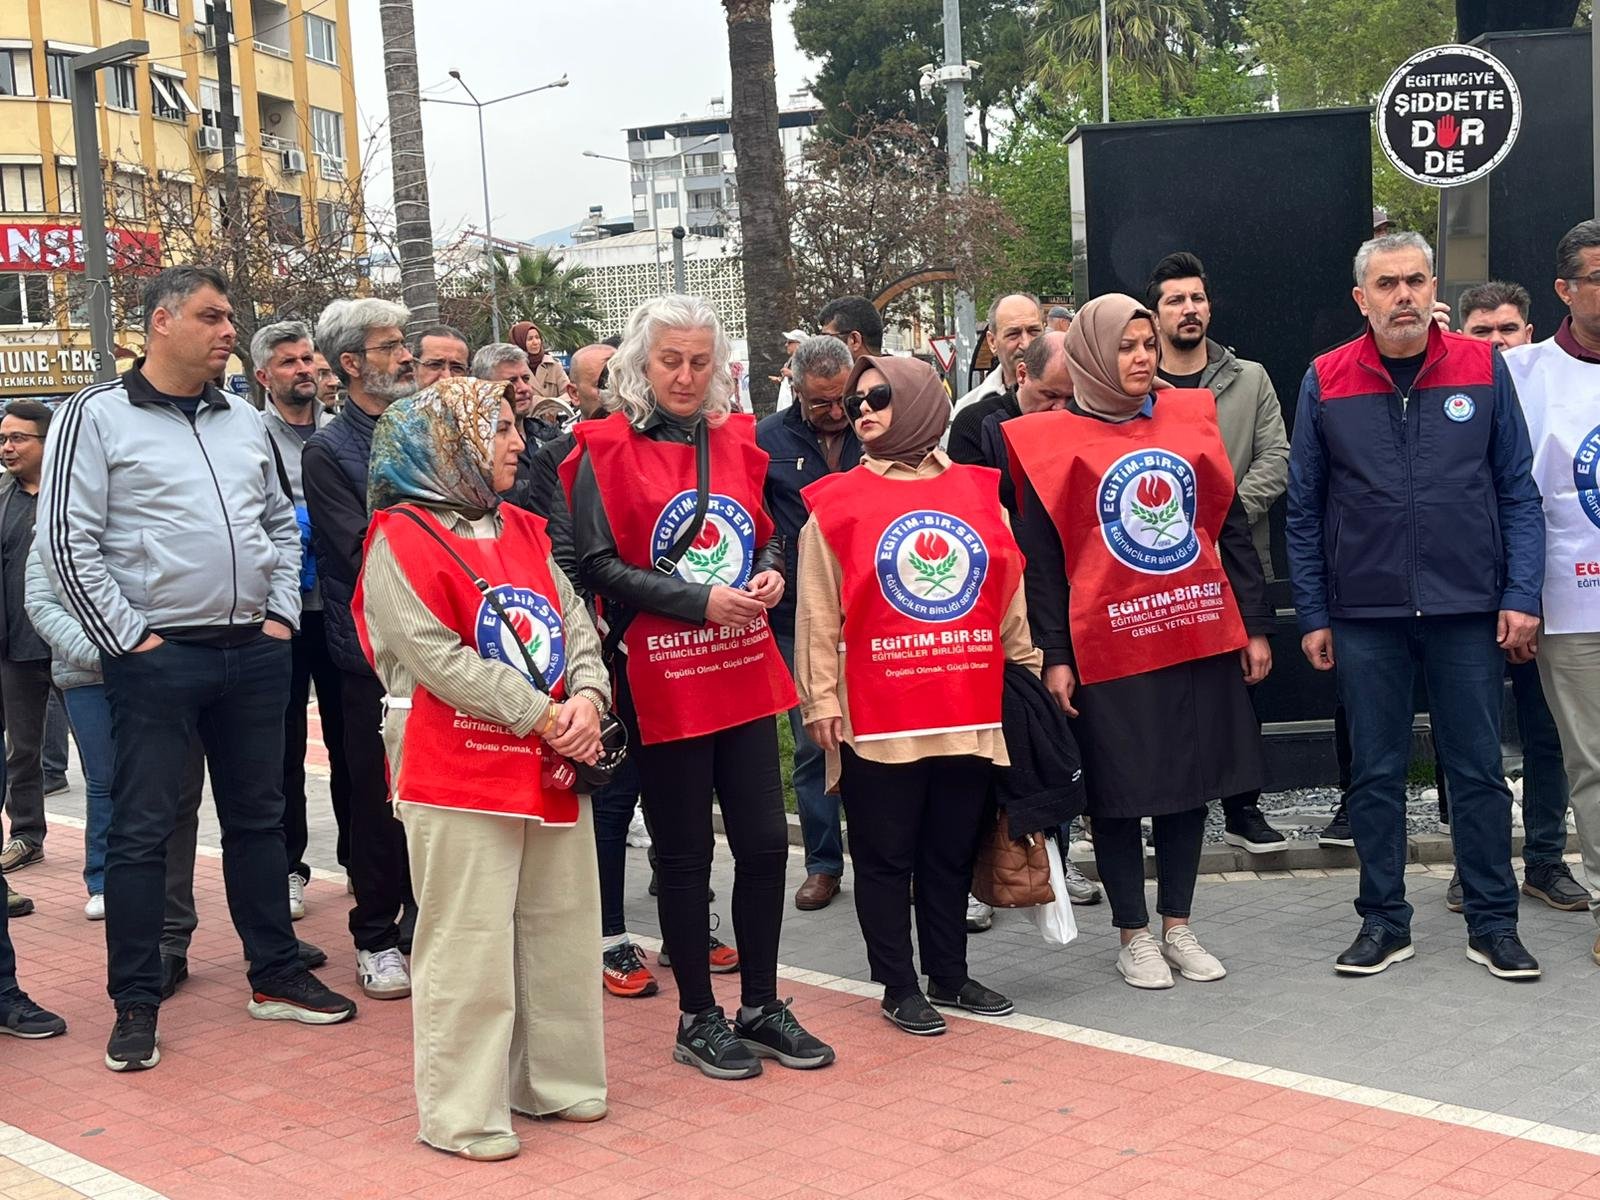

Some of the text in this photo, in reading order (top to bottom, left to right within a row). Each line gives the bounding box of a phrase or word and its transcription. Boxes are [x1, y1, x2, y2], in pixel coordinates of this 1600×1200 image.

[1394, 89, 1504, 117] ŞİDDETE
[1424, 150, 1465, 174] DE
[4, 376, 36, 387] EKMEK
[37, 376, 58, 386] FAB.
[1131, 623, 1163, 638] GENEL
